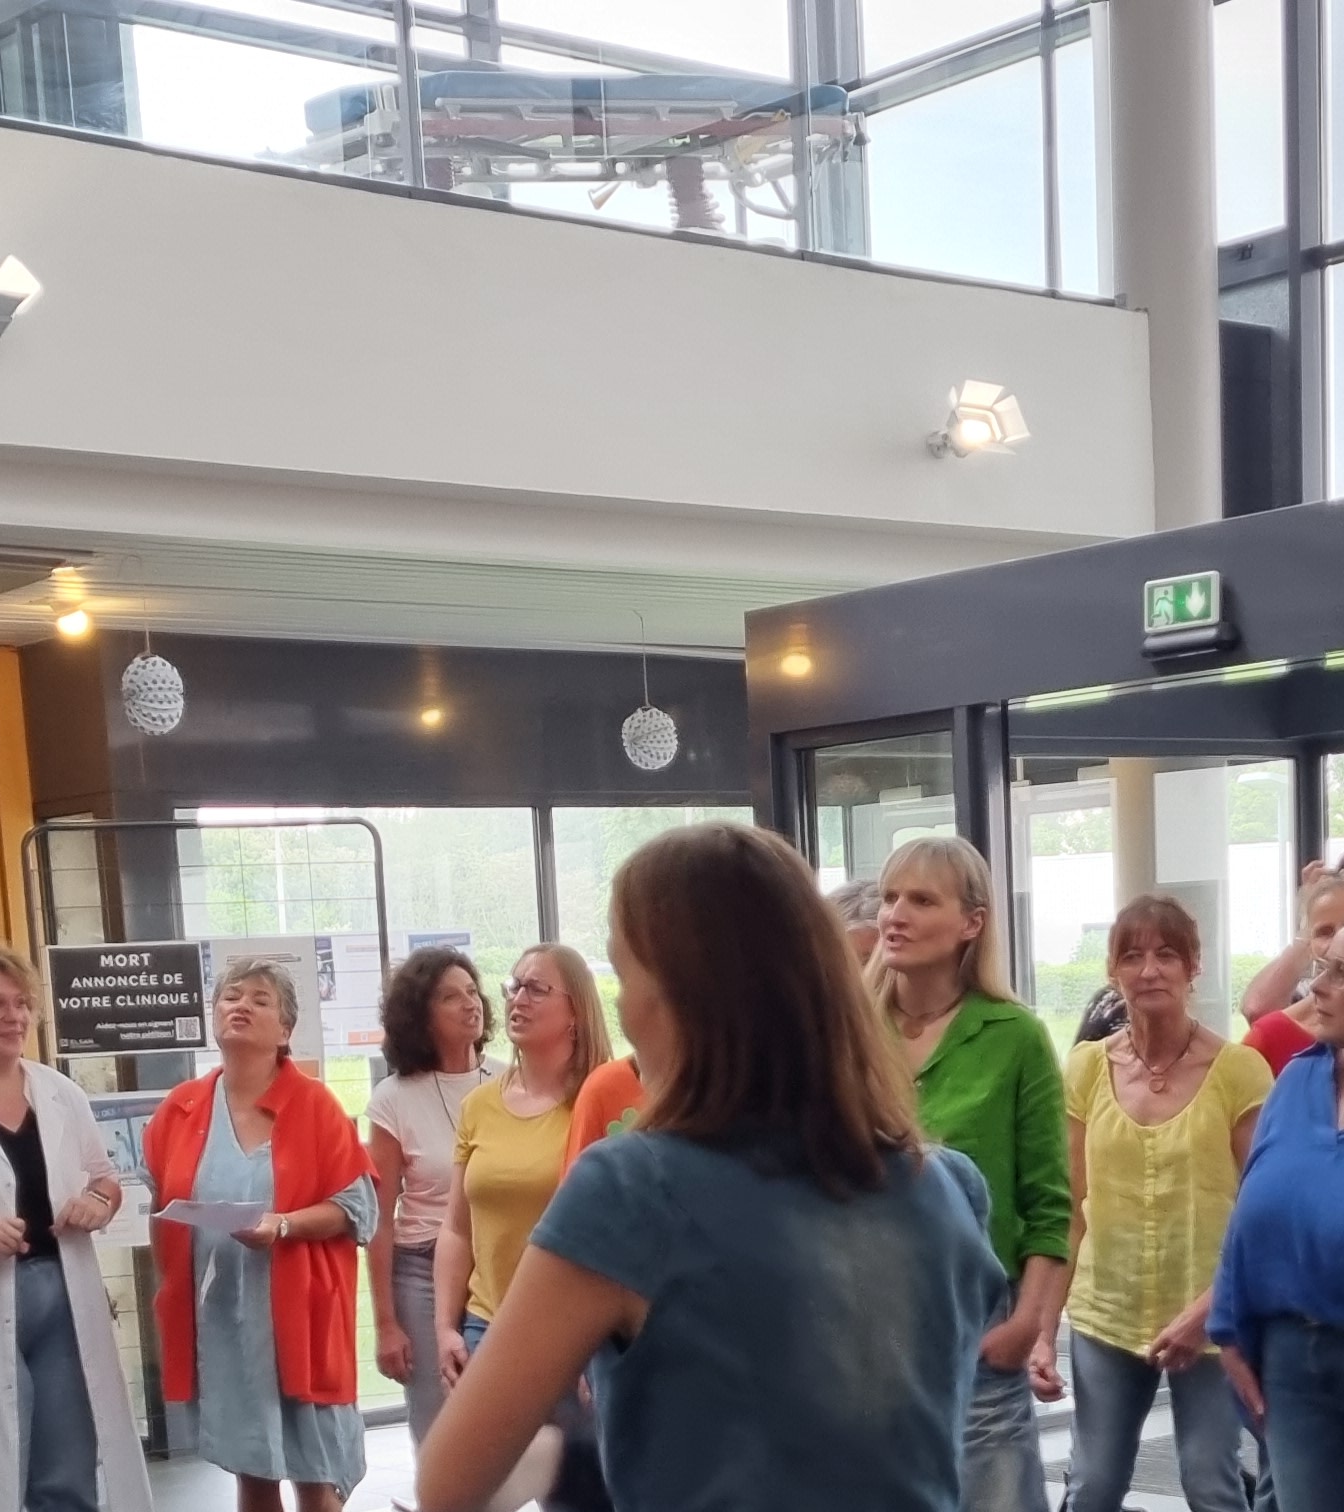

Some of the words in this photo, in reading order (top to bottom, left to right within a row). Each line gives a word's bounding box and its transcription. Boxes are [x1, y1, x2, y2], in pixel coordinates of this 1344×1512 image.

[100, 953, 151, 968] MORT
[71, 971, 159, 988] ANNONCÉE
[163, 973, 184, 985] DE
[59, 995, 111, 1009] VOTRE
[116, 993, 189, 1007] CLINIQUE
